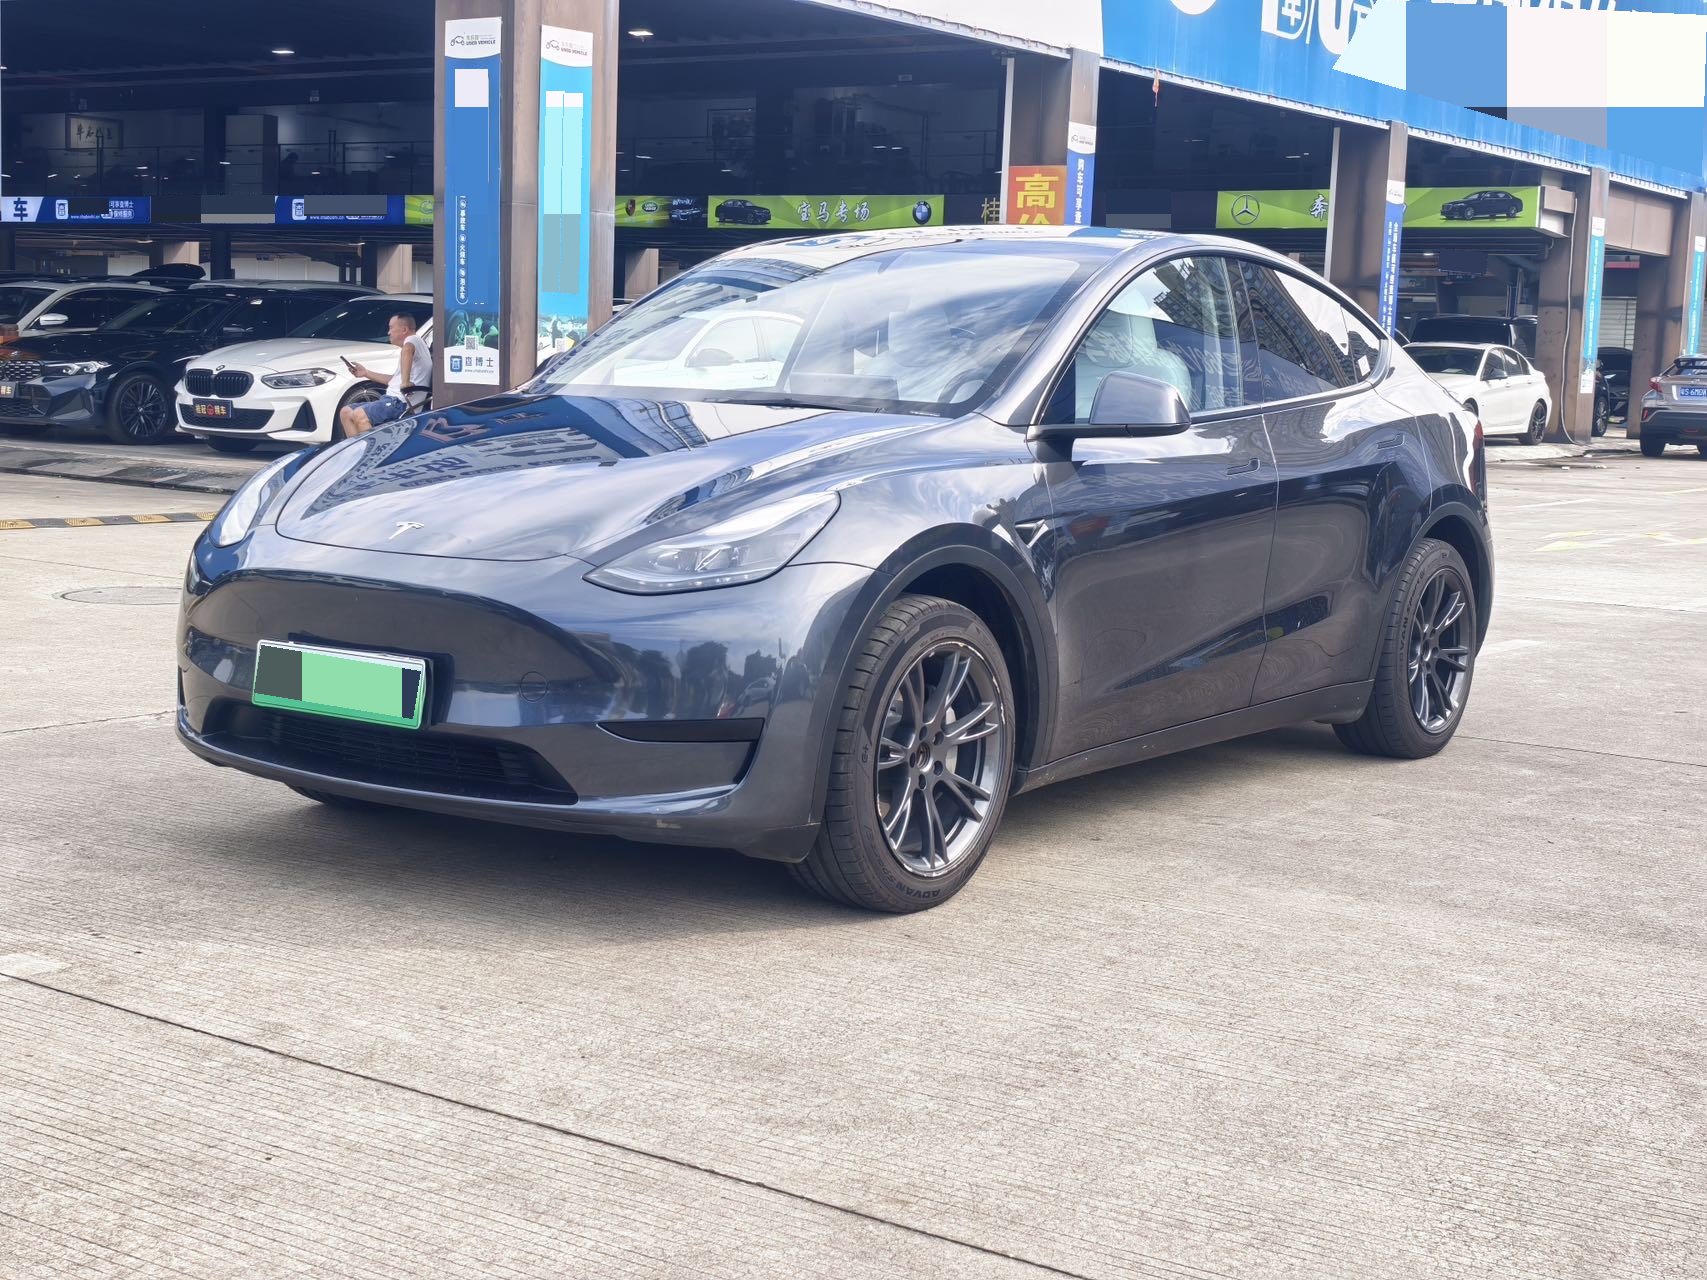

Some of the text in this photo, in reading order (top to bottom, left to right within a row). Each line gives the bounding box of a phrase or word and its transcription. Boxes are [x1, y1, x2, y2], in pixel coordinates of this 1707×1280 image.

[13, 197, 28, 221] 车
[797, 201, 870, 222] 宝马专场
[1309, 194, 1328, 221] 奔
[465, 356, 494, 368] 查博士
[895, 881, 941, 898] ADVAN
